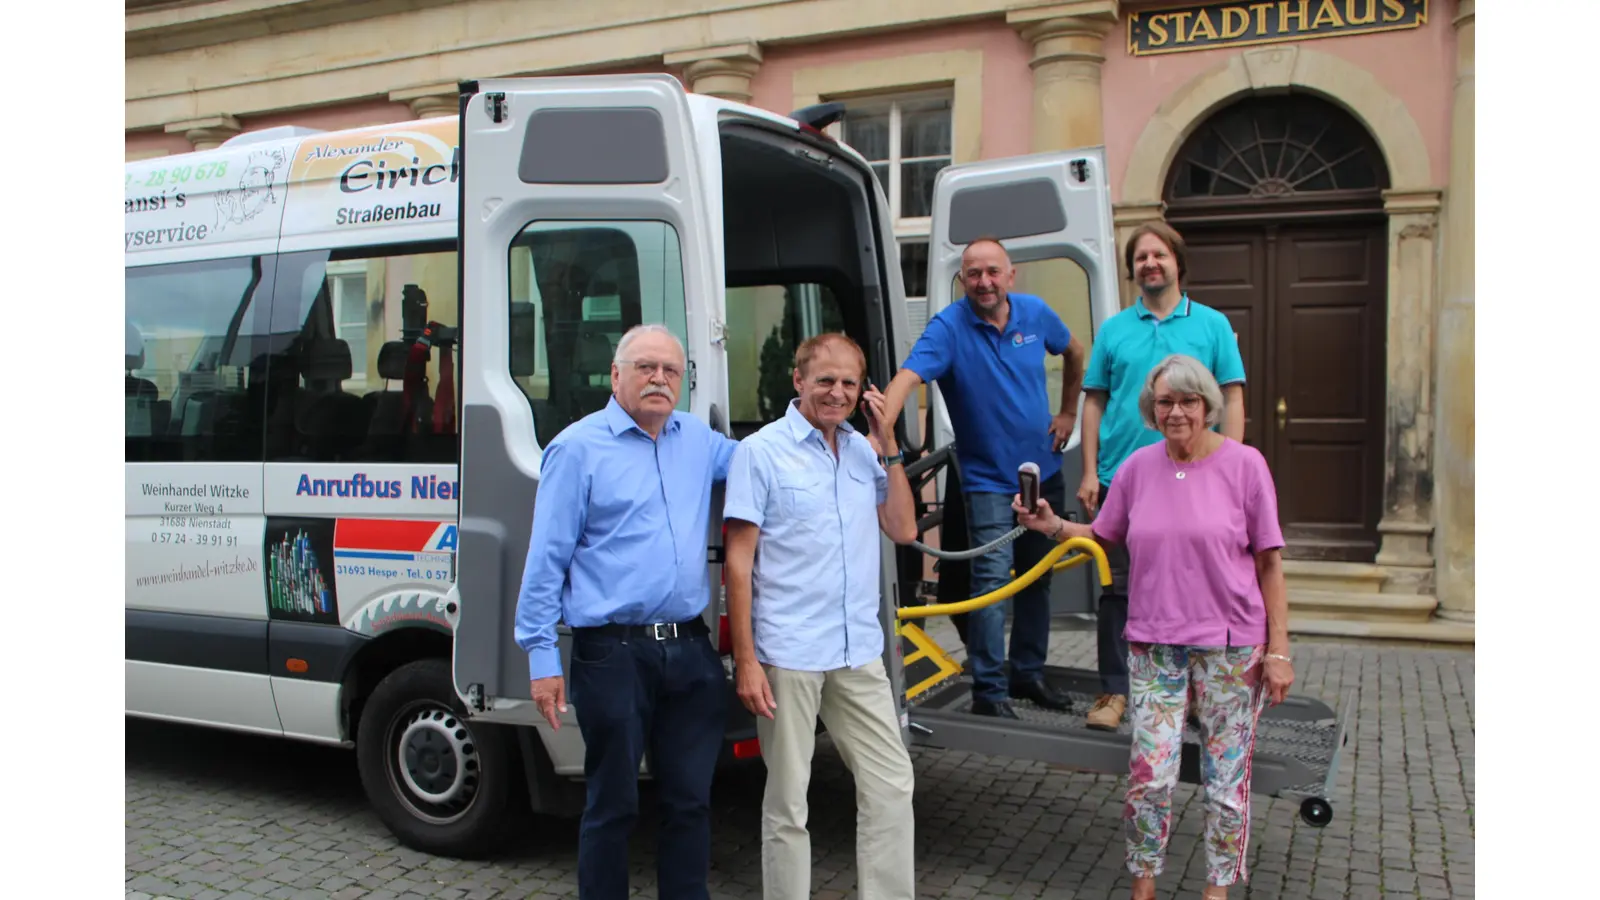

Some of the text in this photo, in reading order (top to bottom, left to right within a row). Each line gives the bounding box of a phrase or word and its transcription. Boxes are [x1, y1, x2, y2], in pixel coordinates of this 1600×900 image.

[1148, 0, 1405, 46] STADTHAUS
[304, 138, 404, 162] Alexander
[145, 168, 168, 187] 28
[171, 165, 192, 184] 90
[195, 161, 230, 180] 678
[335, 202, 441, 225] Straßenbau
[142, 484, 250, 499] Weinhandel Witzke
[296, 473, 402, 499] Anrufbus
[164, 502, 224, 516] Kurzer Weg 4
[159, 516, 186, 527] 31688
[151, 532, 157, 543] 0
[160, 533, 171, 543] 57
[174, 533, 186, 544] 24
[195, 534, 208, 546] 39
[211, 535, 222, 546] 91
[226, 536, 237, 547] 91
[136, 555, 258, 587] www.weinhandel-witzke.de
[336, 564, 448, 580] 31693 Hespe Tel. 0 57
